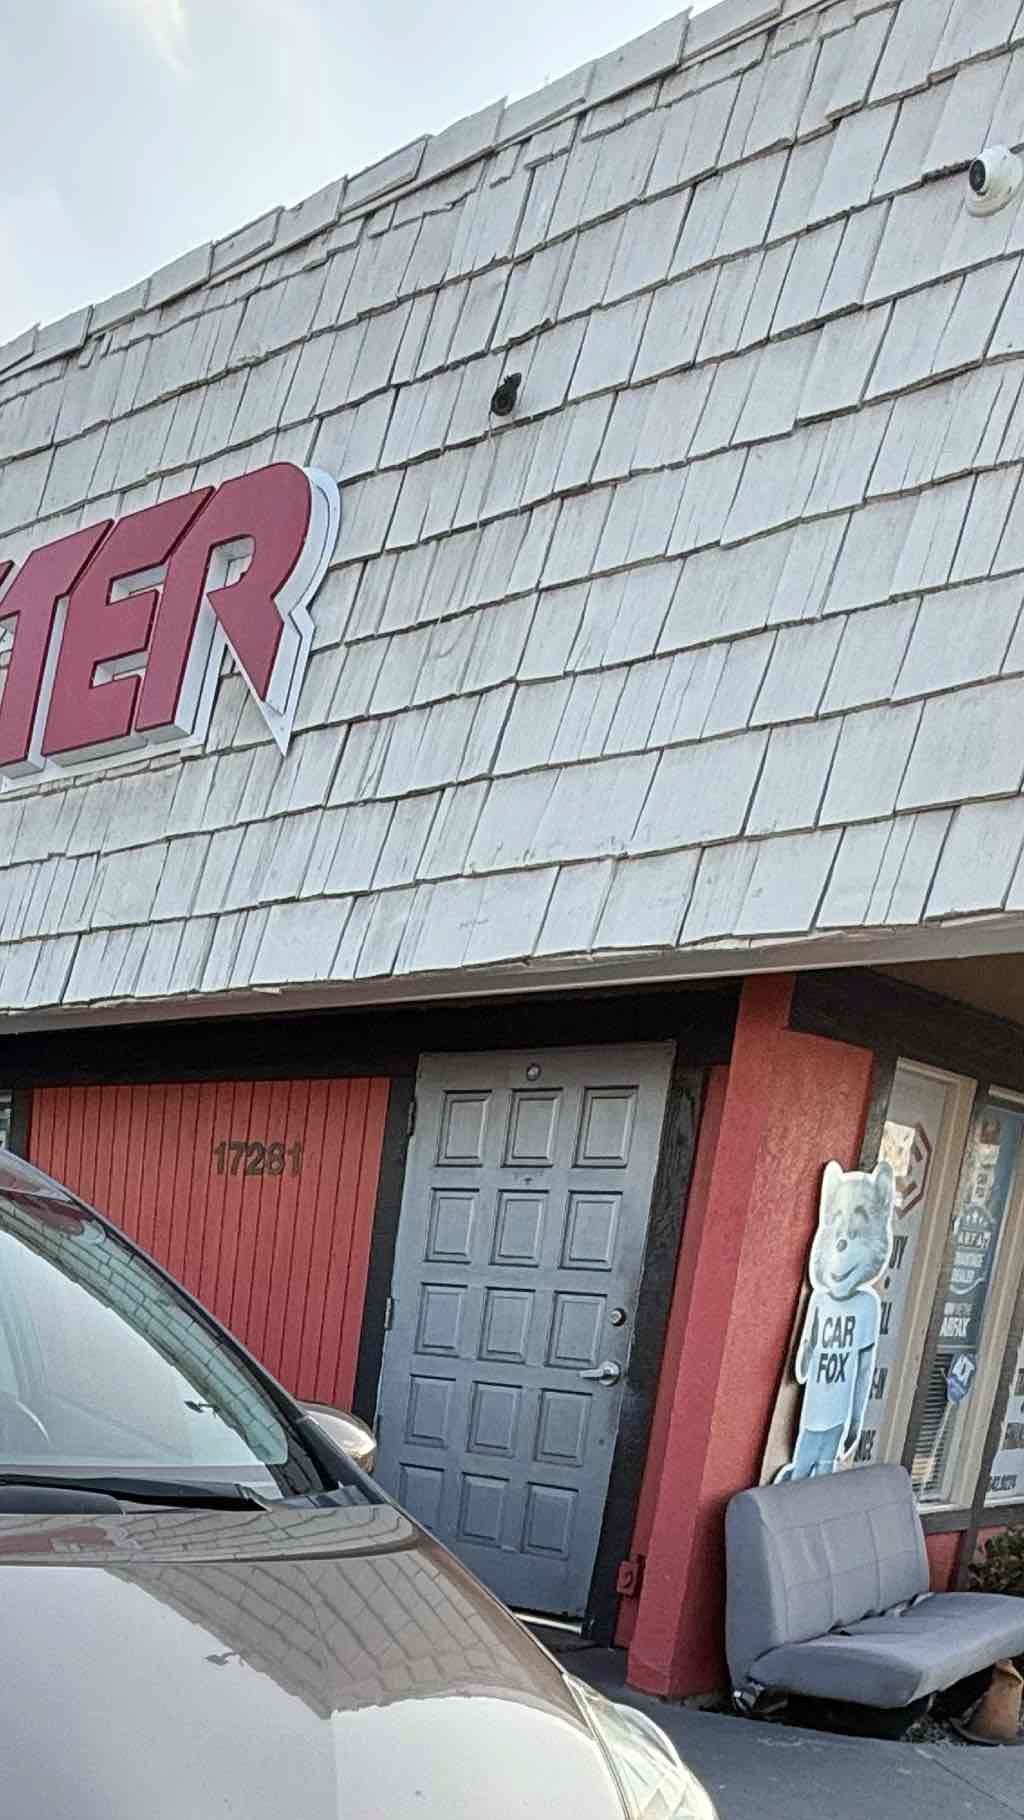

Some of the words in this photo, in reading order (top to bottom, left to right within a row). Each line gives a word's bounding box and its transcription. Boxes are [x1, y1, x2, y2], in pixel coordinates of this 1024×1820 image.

[214, 1139, 302, 1177] 17281
[822, 1315, 856, 1348] CAR
[816, 1351, 850, 1384] FOX
